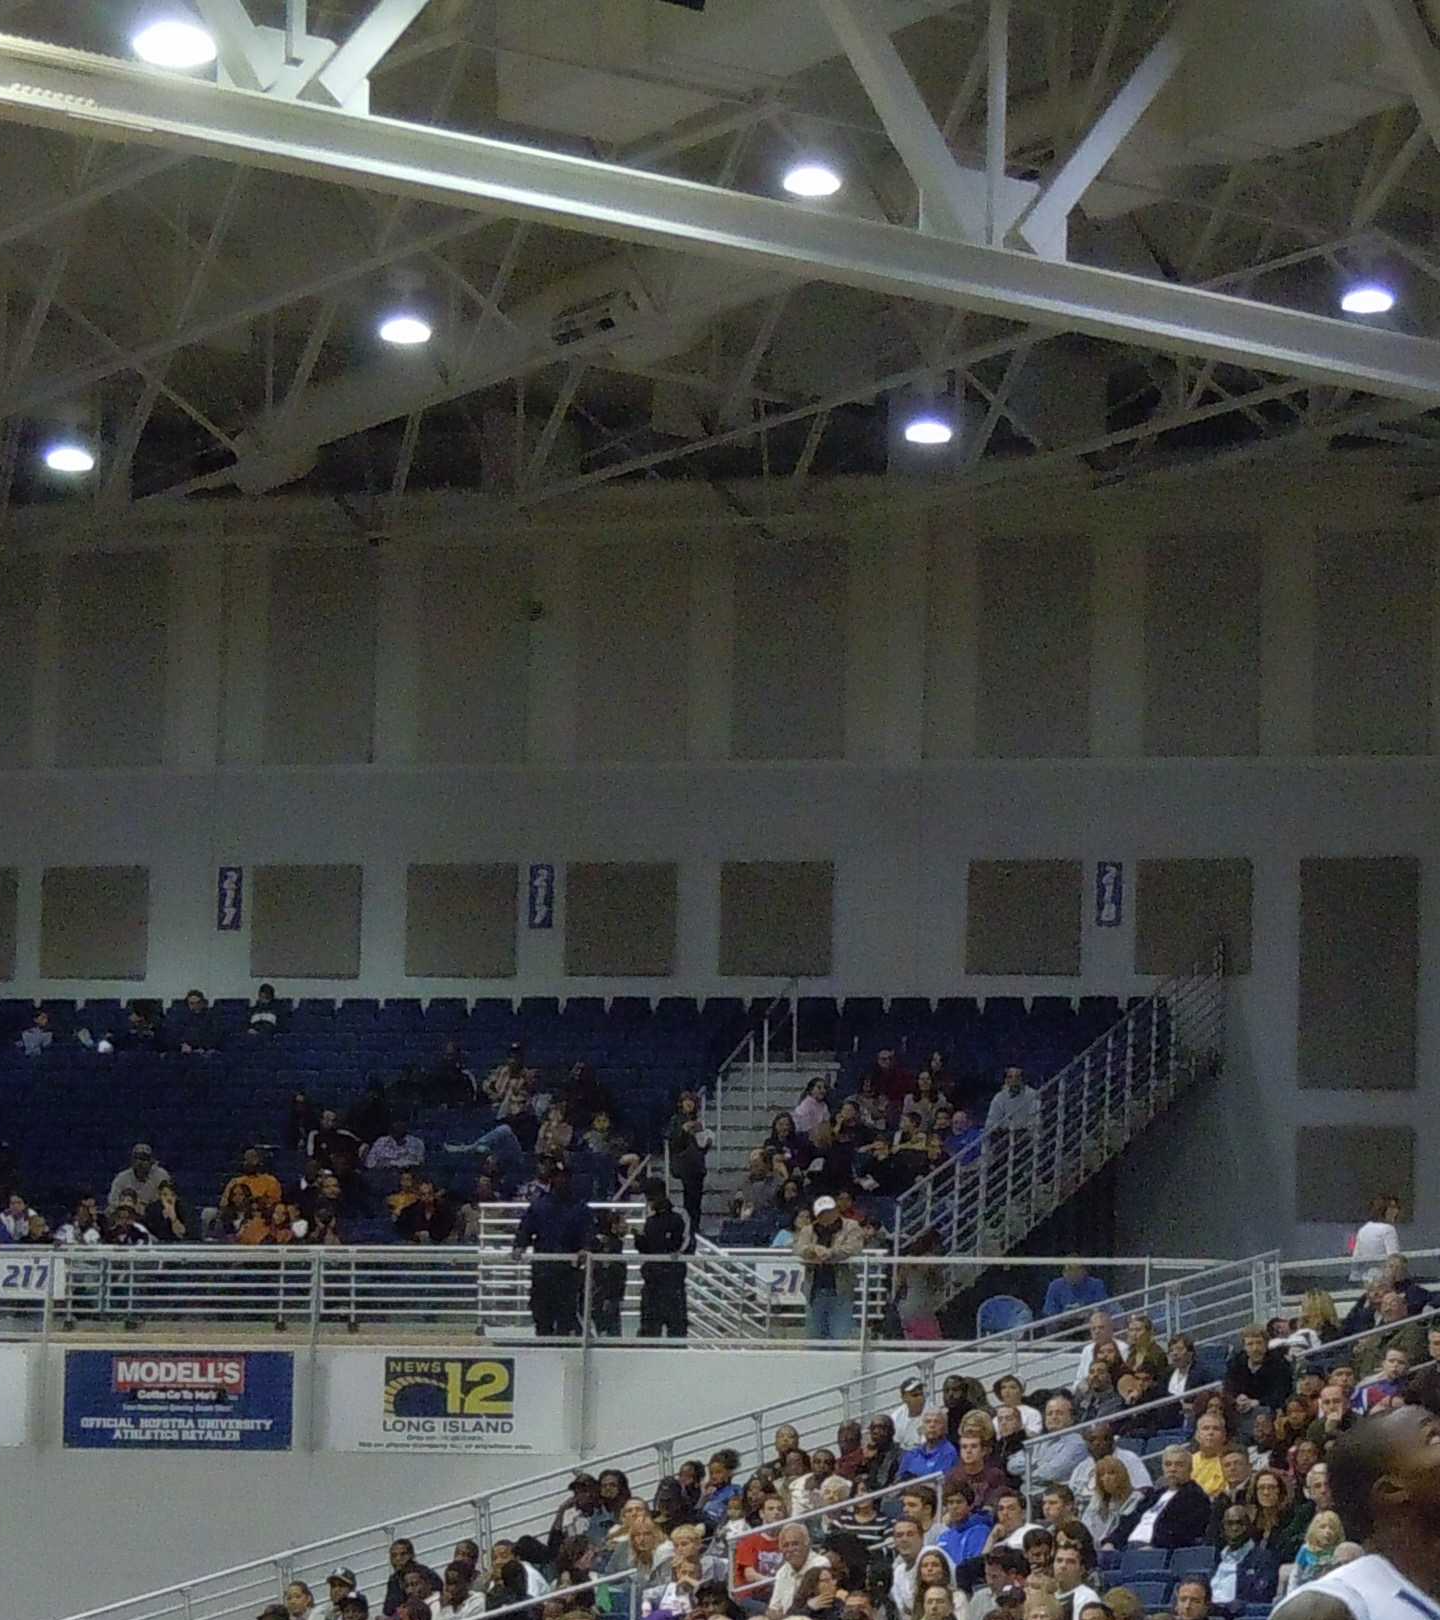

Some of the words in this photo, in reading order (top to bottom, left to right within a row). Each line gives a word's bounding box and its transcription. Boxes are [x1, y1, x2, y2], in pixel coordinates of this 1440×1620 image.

[222, 871, 238, 926] 217
[533, 868, 548, 924] 217
[1, 1265, 49, 1288] 217
[771, 1269, 801, 1293] 21
[117, 1361, 241, 1383] MODELL'S
[389, 1361, 442, 1374] NEWS
[445, 1361, 514, 1415] 12
[80, 1417, 134, 1429] OFFICIAL
[140, 1417, 195, 1430] HOFSTRA
[198, 1418, 273, 1431] UNIVERSITY
[113, 1429, 180, 1441] ATHLETICS
[382, 1419, 436, 1434] LONG
[442, 1420, 514, 1435] ISLAND
